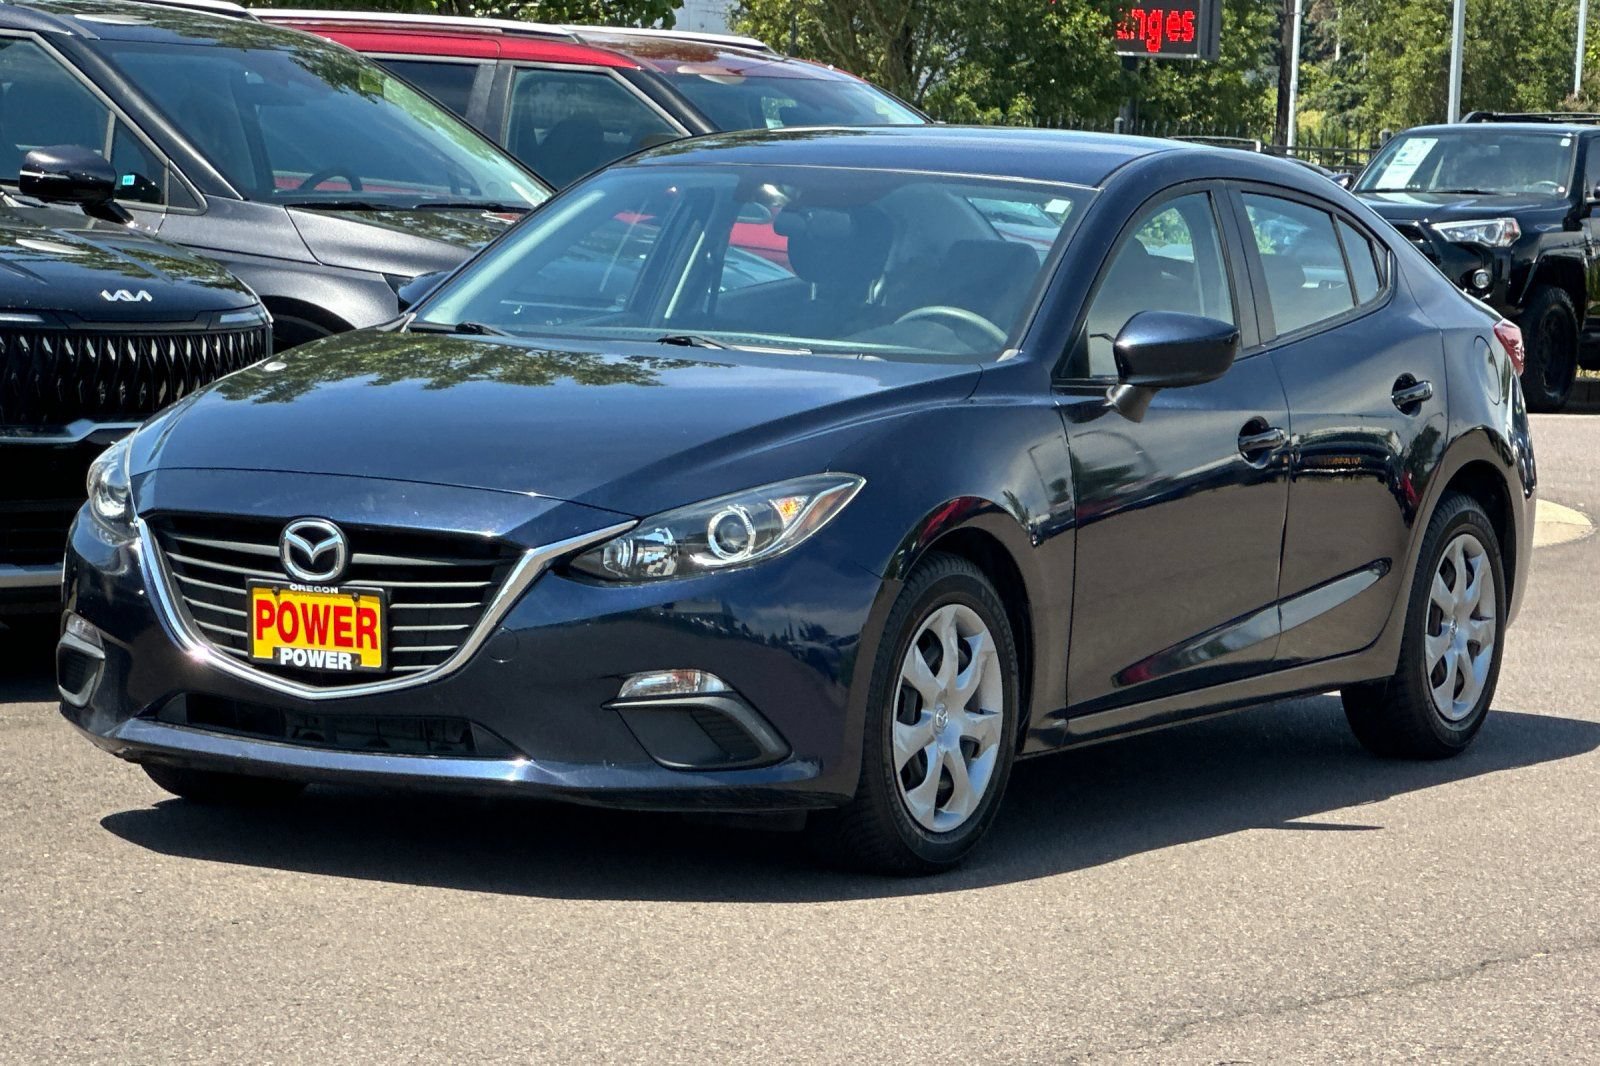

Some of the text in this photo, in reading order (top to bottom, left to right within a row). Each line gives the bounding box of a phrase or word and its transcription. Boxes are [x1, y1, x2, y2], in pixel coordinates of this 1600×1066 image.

[289, 584, 339, 594] OREGON
[255, 599, 378, 650] POWER
[279, 648, 352, 671] POWER
